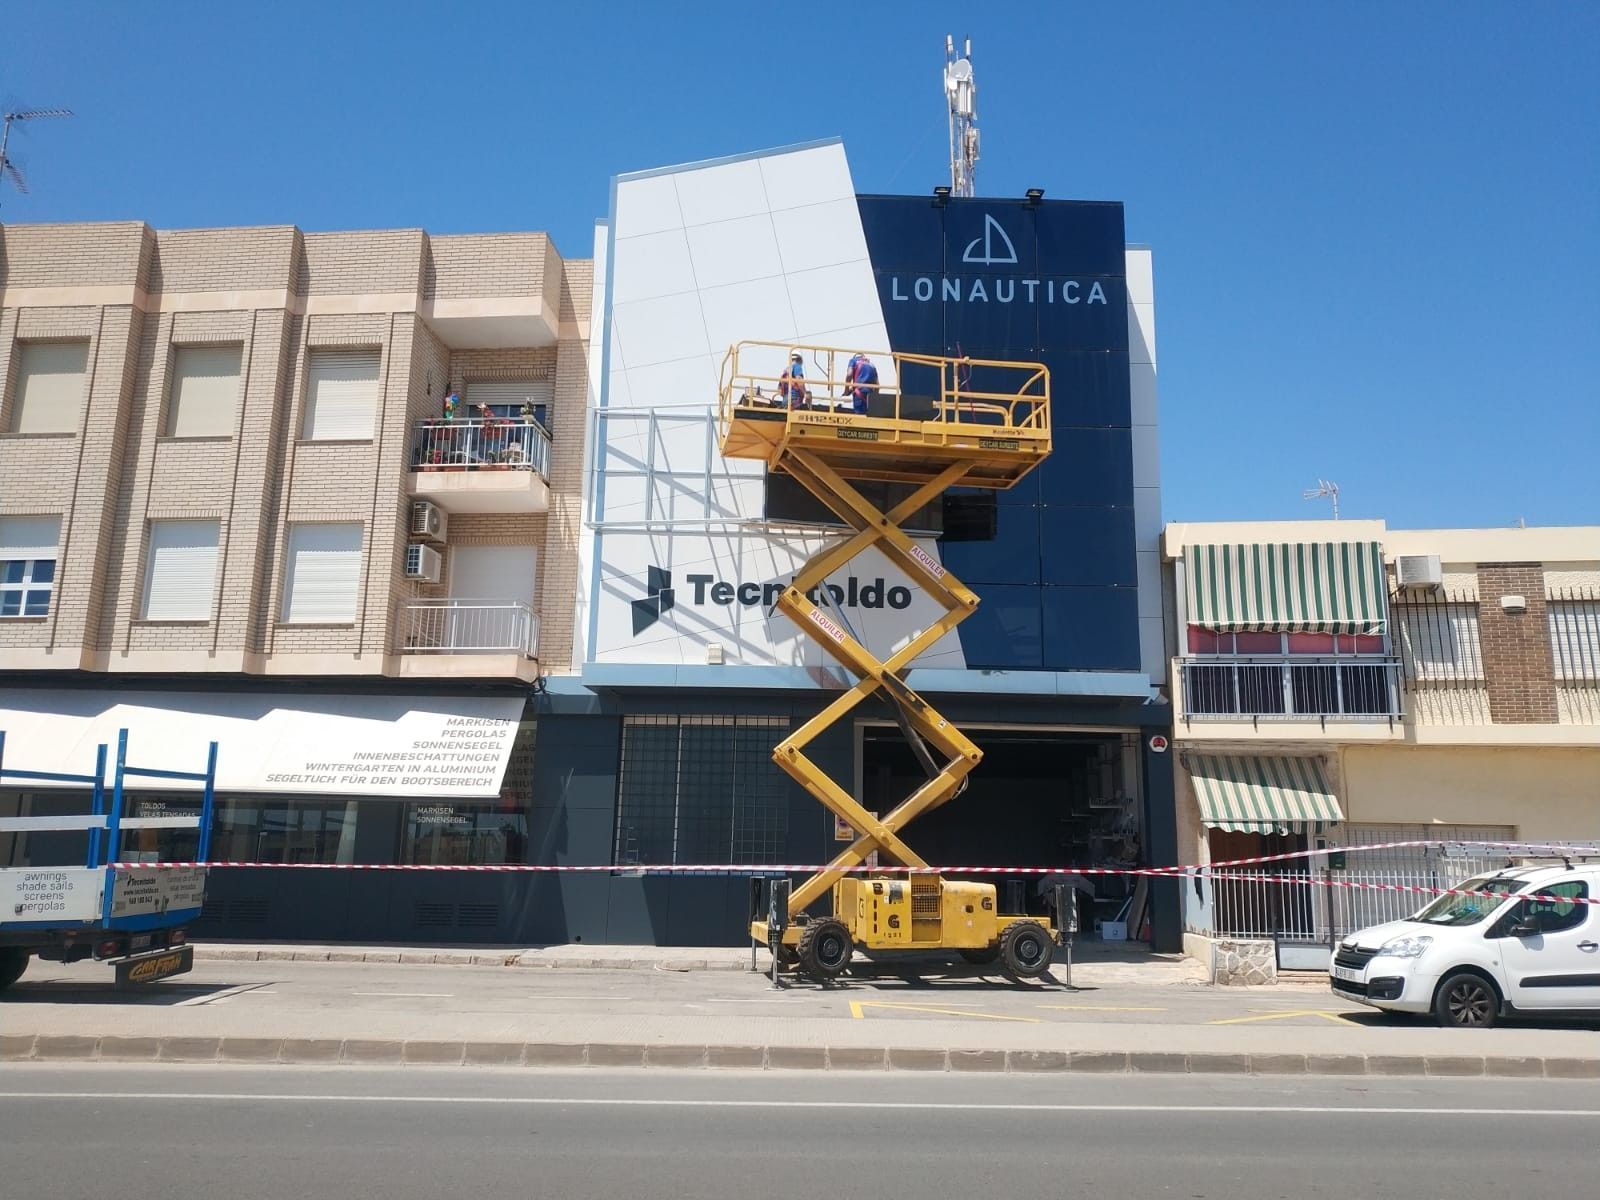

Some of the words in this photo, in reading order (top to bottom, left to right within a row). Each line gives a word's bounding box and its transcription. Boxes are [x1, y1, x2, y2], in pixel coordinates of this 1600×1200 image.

[892, 277, 1107, 305] LONAUTICA
[911, 547, 945, 577] ALQUILER
[686, 574, 912, 609] Tecntoldo
[811, 611, 845, 642] ALQUILER
[446, 718, 511, 727] MARKISEN
[441, 729, 507, 738] PERGOLAS
[412, 741, 503, 750] SONNENSEGEL
[353, 752, 500, 762] INNENBESCHATTUNGEN
[305, 763, 405, 773] WINTERGARTEN
[407, 764, 421, 773] IN
[423, 765, 497, 774] ALUMINIUM
[265, 774, 337, 783] SEGELTUCH
[340, 774, 367, 784] FÜR
[370, 776, 397, 785] DEN
[401, 776, 493, 786] BOOTSBEREICH
[140, 802, 166, 810] TOLDOS
[417, 807, 454, 815] MARKISEN
[416, 816, 467, 824] SONNENSEGEL
[25, 872, 67, 882] awnings
[16, 881, 47, 891] shade
[50, 881, 73, 890] sails
[24, 892, 64, 901] screens
[22, 901, 65, 913] pergolas
